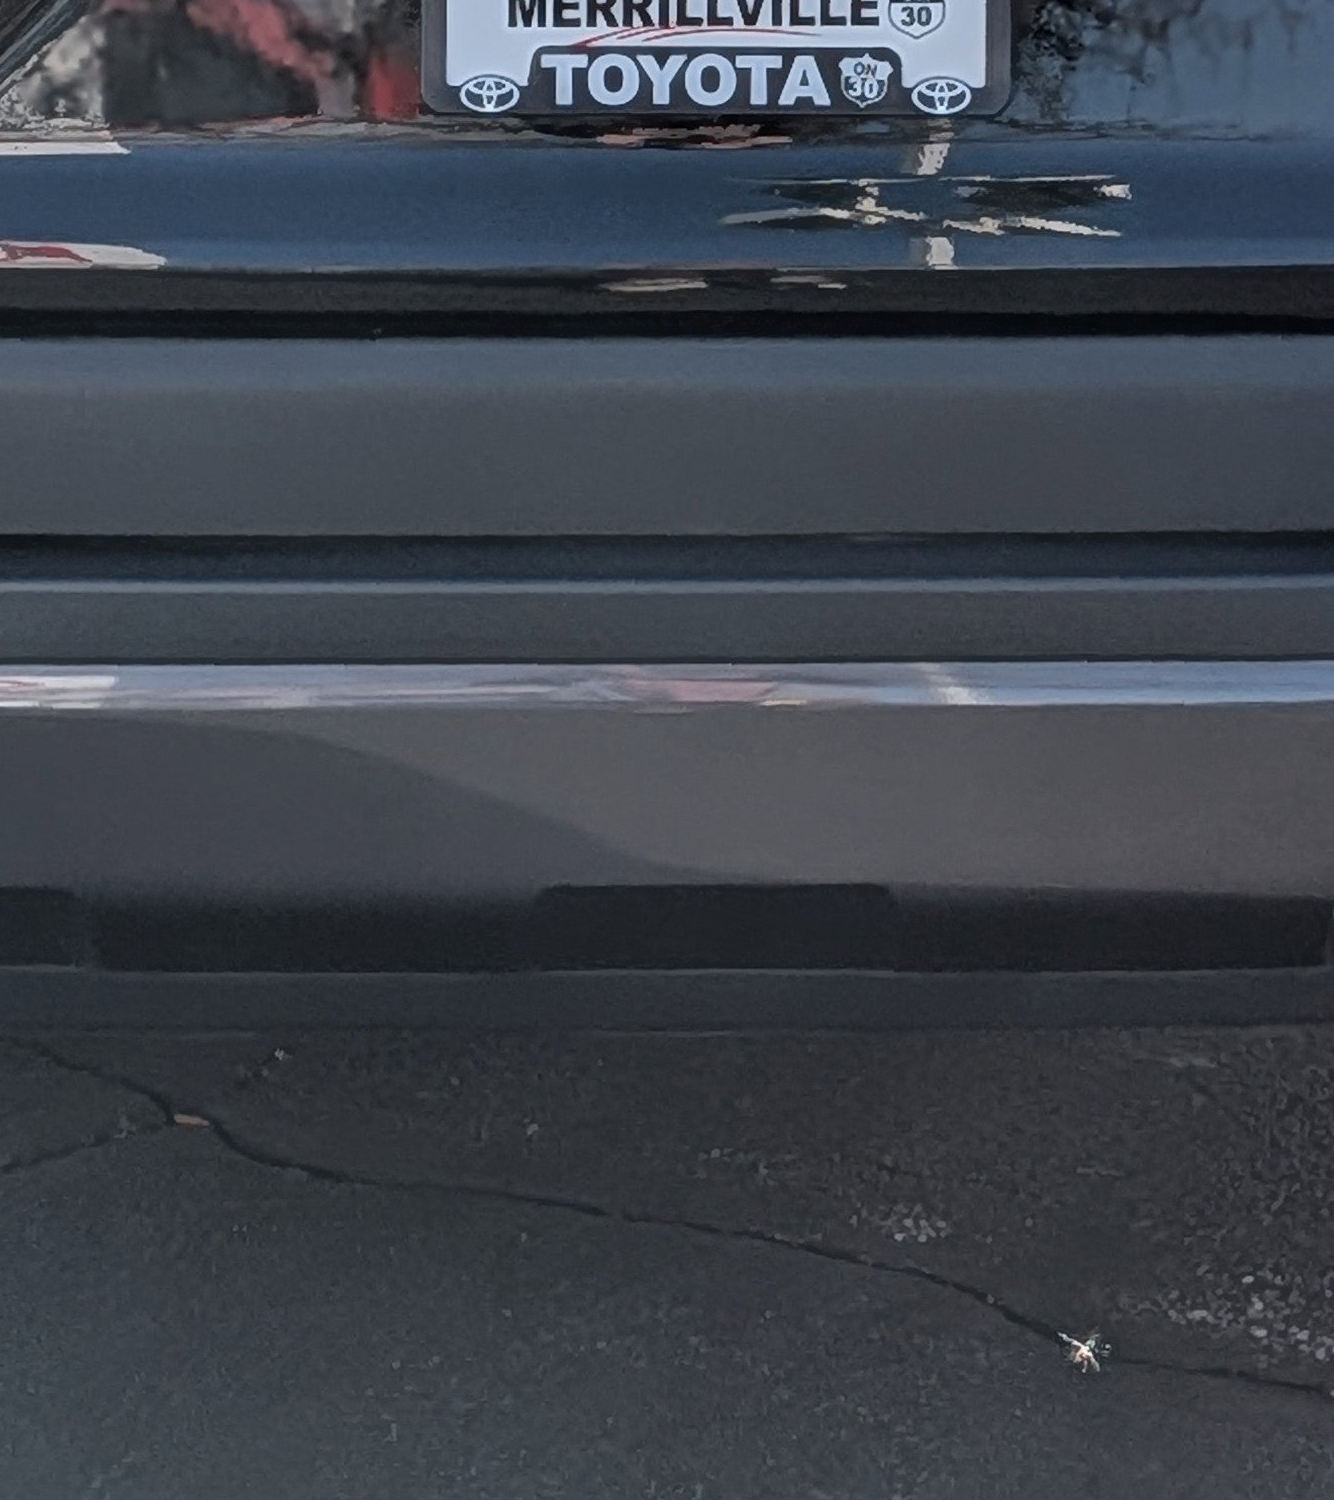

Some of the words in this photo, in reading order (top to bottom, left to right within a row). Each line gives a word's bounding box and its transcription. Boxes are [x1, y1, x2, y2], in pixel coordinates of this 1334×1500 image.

[900, 5, 933, 27] 30
[853, 61, 878, 76] ON
[540, 53, 832, 107] TOYOTA
[846, 76, 880, 98] 30
